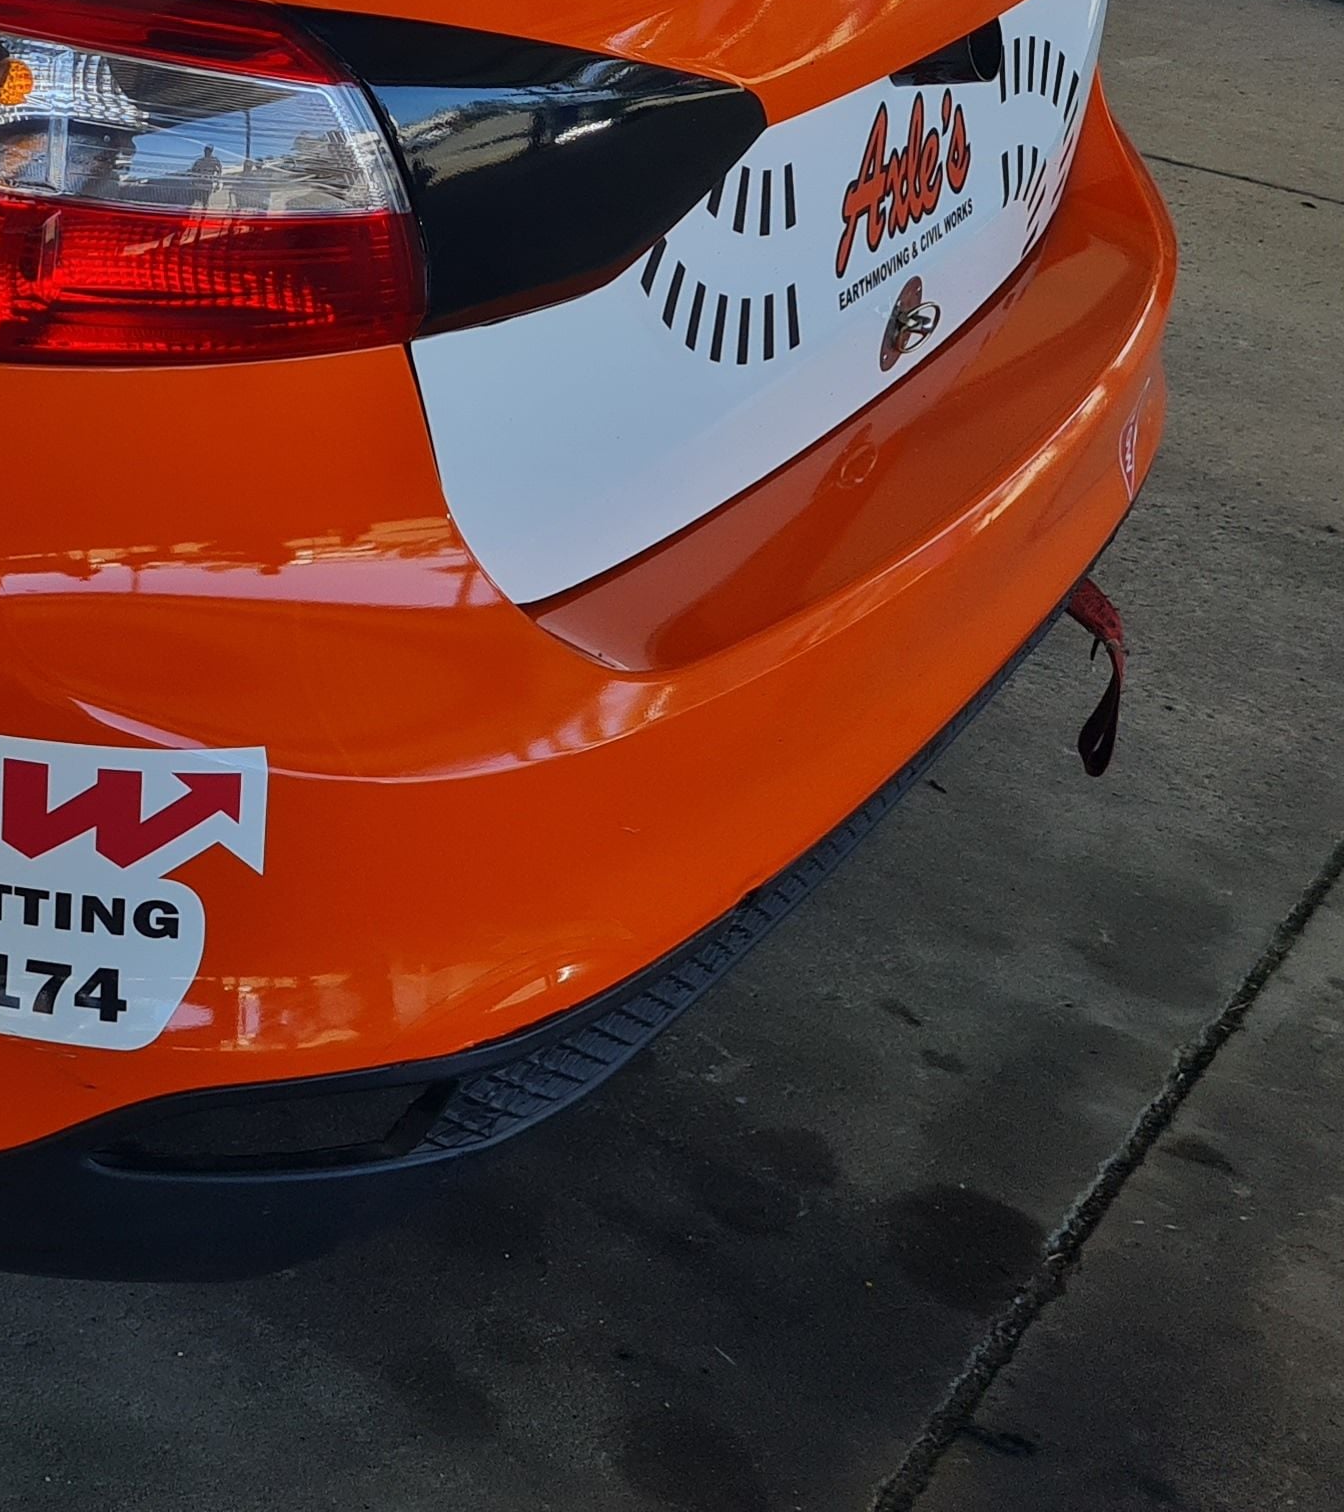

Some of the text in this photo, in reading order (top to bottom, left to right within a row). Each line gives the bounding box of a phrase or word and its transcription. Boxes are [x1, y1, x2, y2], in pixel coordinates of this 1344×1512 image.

[834, 87, 972, 278] Axle's
[837, 197, 974, 312] EARTHMOVING & CIVIL WORKS
